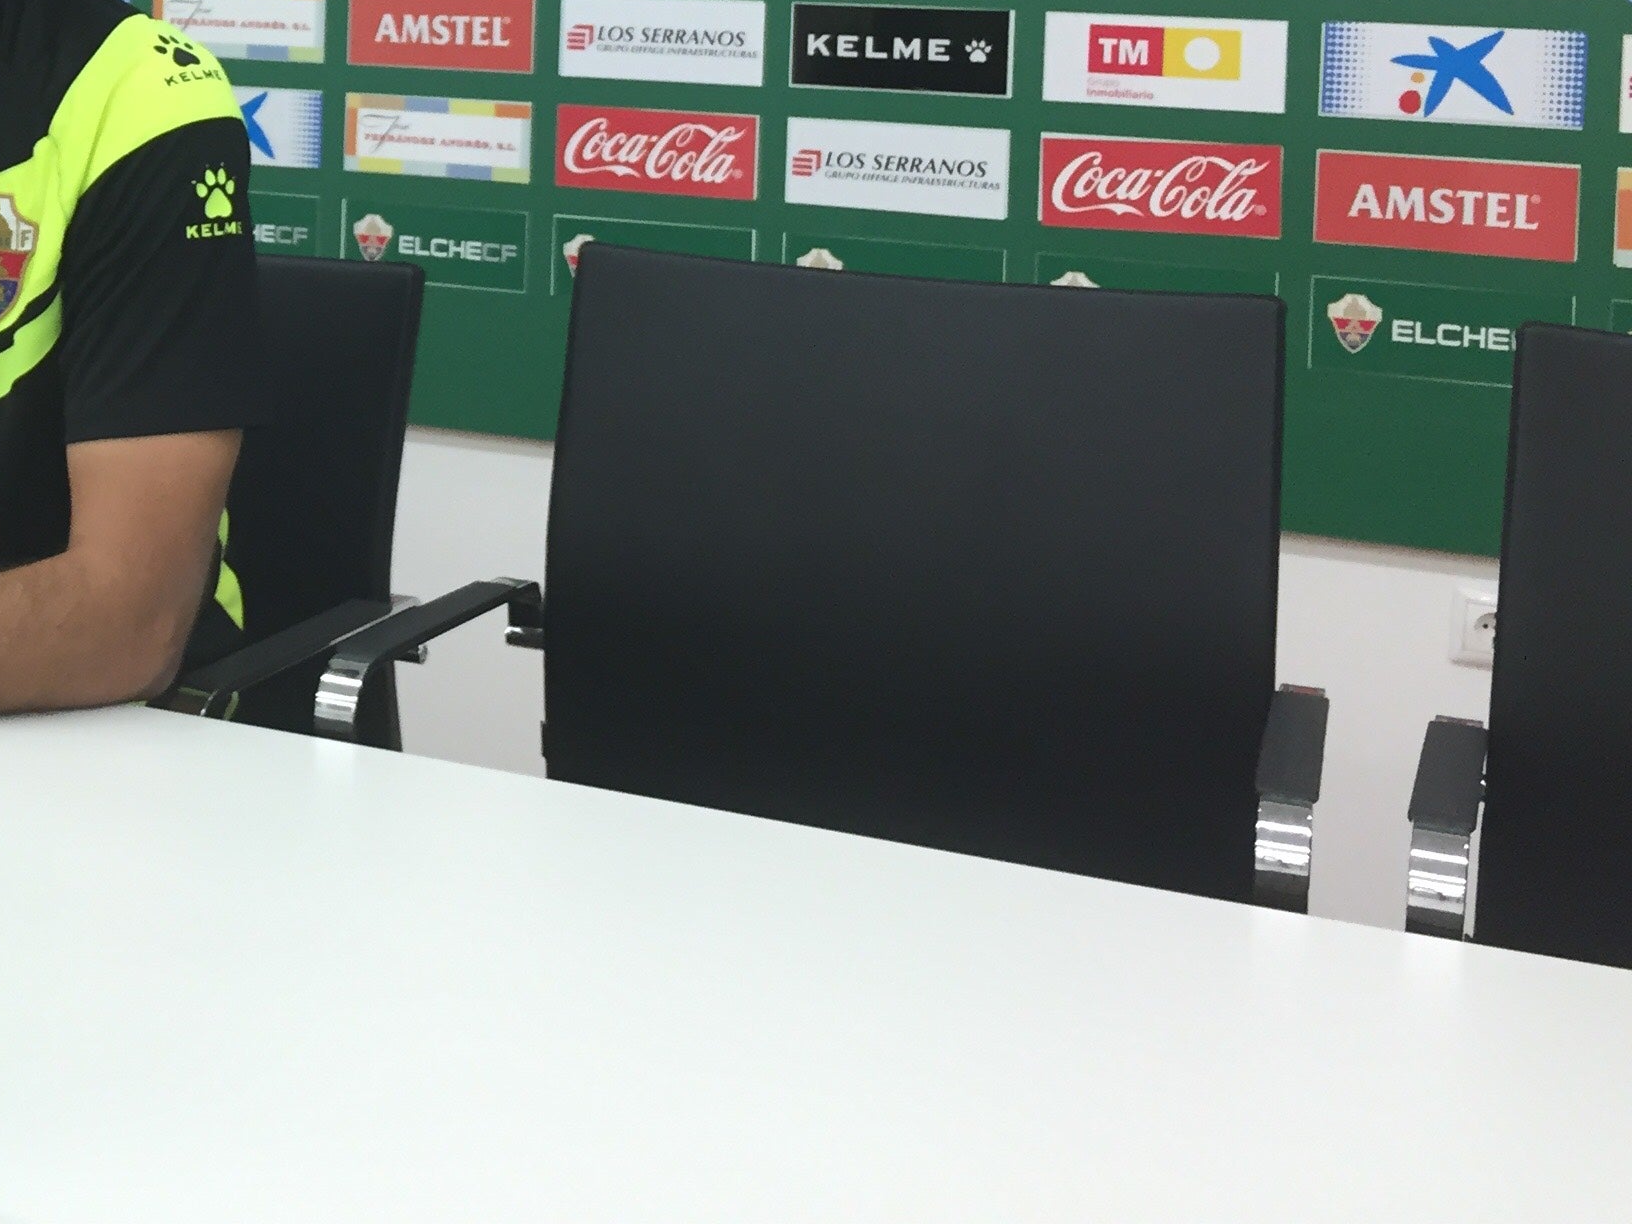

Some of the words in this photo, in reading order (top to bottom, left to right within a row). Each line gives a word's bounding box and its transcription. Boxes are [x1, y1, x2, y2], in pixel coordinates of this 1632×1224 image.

[374, 13, 511, 47] AMSTEL
[597, 25, 635, 42] LOS
[640, 27, 746, 48] SERRANOS
[806, 33, 952, 62] KELME
[1098, 36, 1150, 66] TM
[563, 116, 748, 185] Coca-Cola
[825, 152, 867, 169] LOS
[872, 154, 988, 178] SERRANOS
[1051, 150, 1272, 222] Coca-Cola
[1347, 183, 1540, 231] AMSTEL
[398, 235, 518, 263] ELCHECF
[1391, 319, 1517, 352] ELCHE
